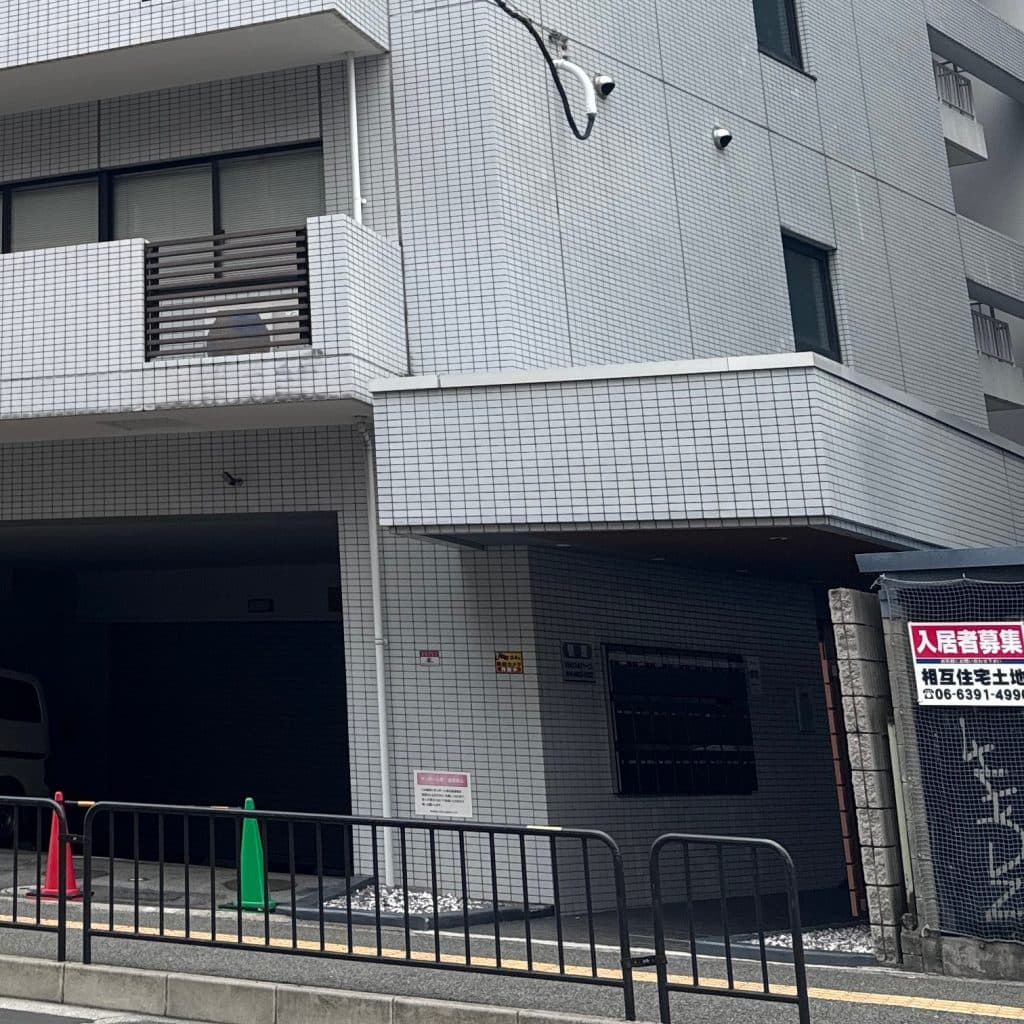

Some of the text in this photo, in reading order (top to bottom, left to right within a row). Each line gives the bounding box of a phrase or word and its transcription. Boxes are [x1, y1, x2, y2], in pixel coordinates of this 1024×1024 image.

[917, 629, 1023, 654] 入居者募集
